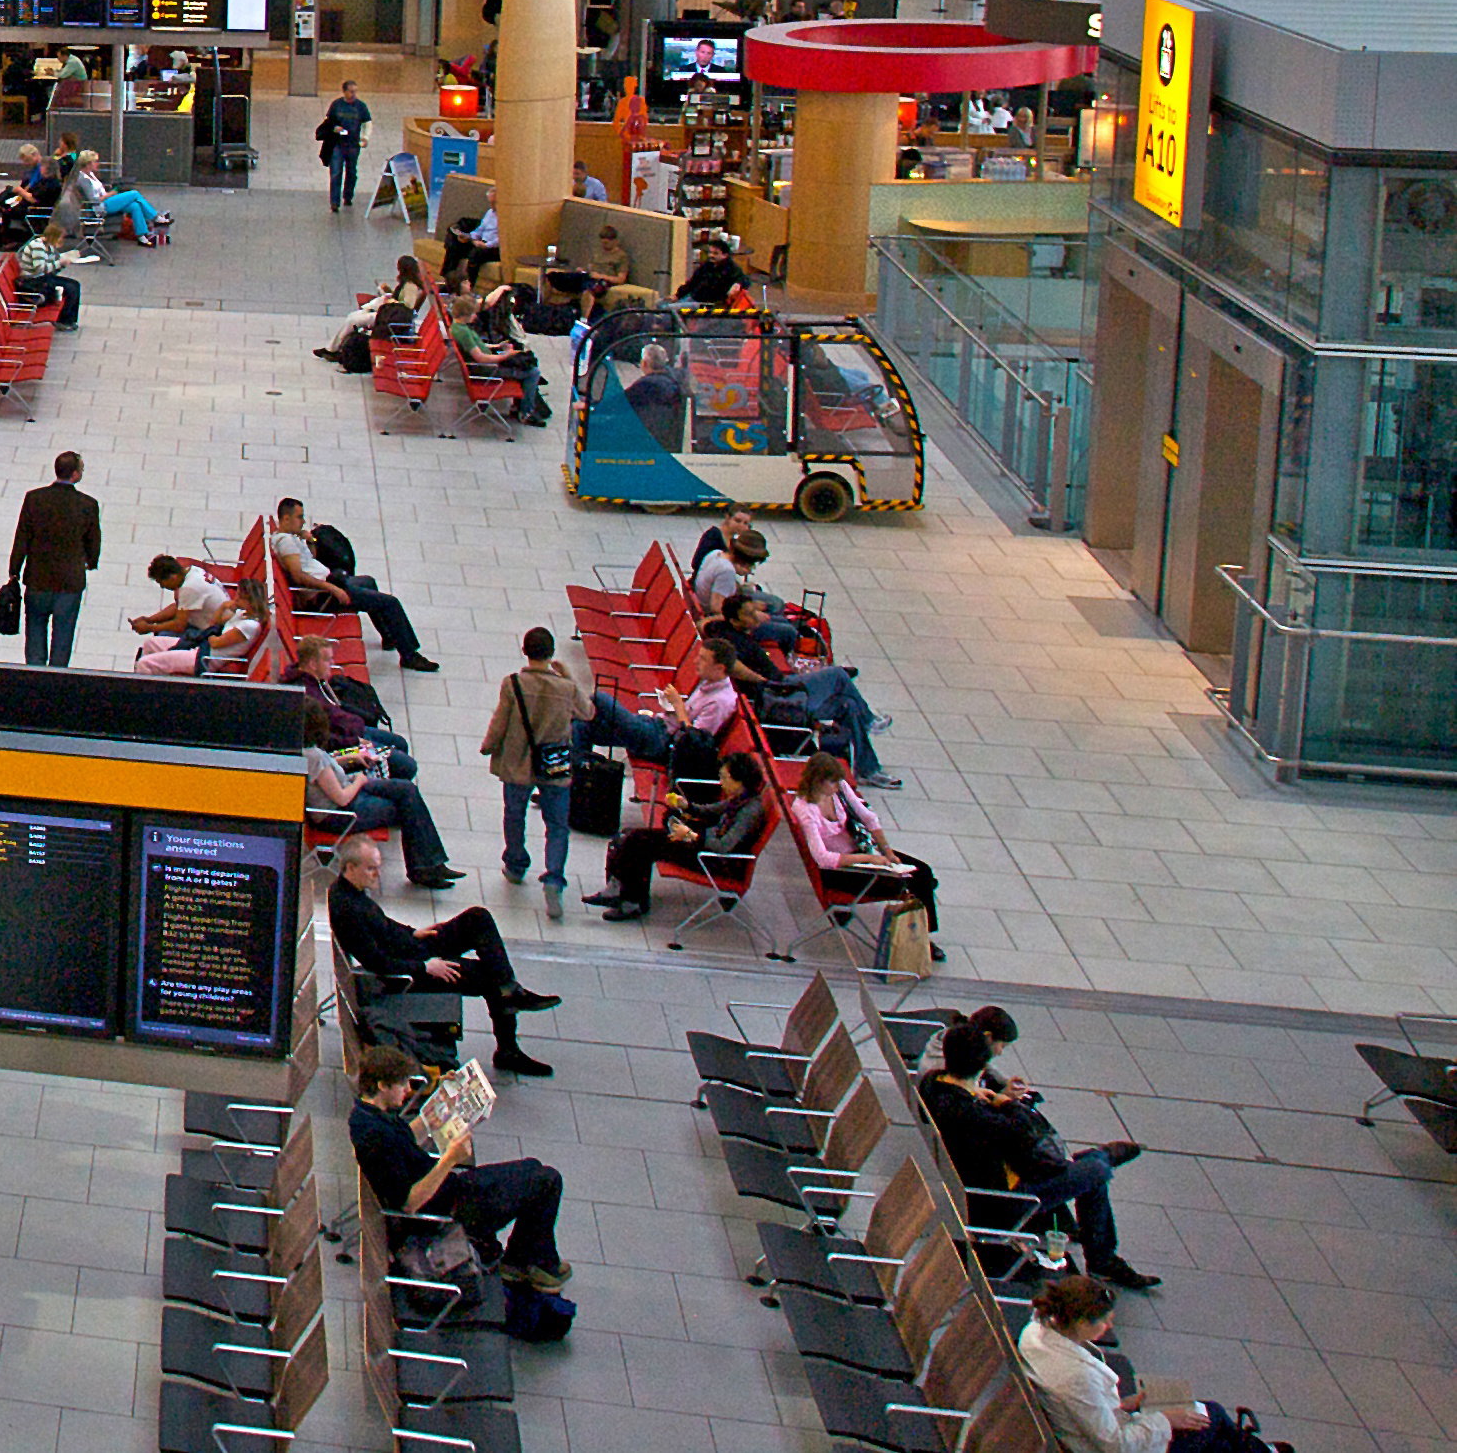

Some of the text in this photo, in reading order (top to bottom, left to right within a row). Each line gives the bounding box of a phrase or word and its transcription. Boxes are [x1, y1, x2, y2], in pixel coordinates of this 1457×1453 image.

[1143, 123, 1177, 178] A10
[166, 834, 245, 850] Your questions
[165, 845, 218, 857] answered
